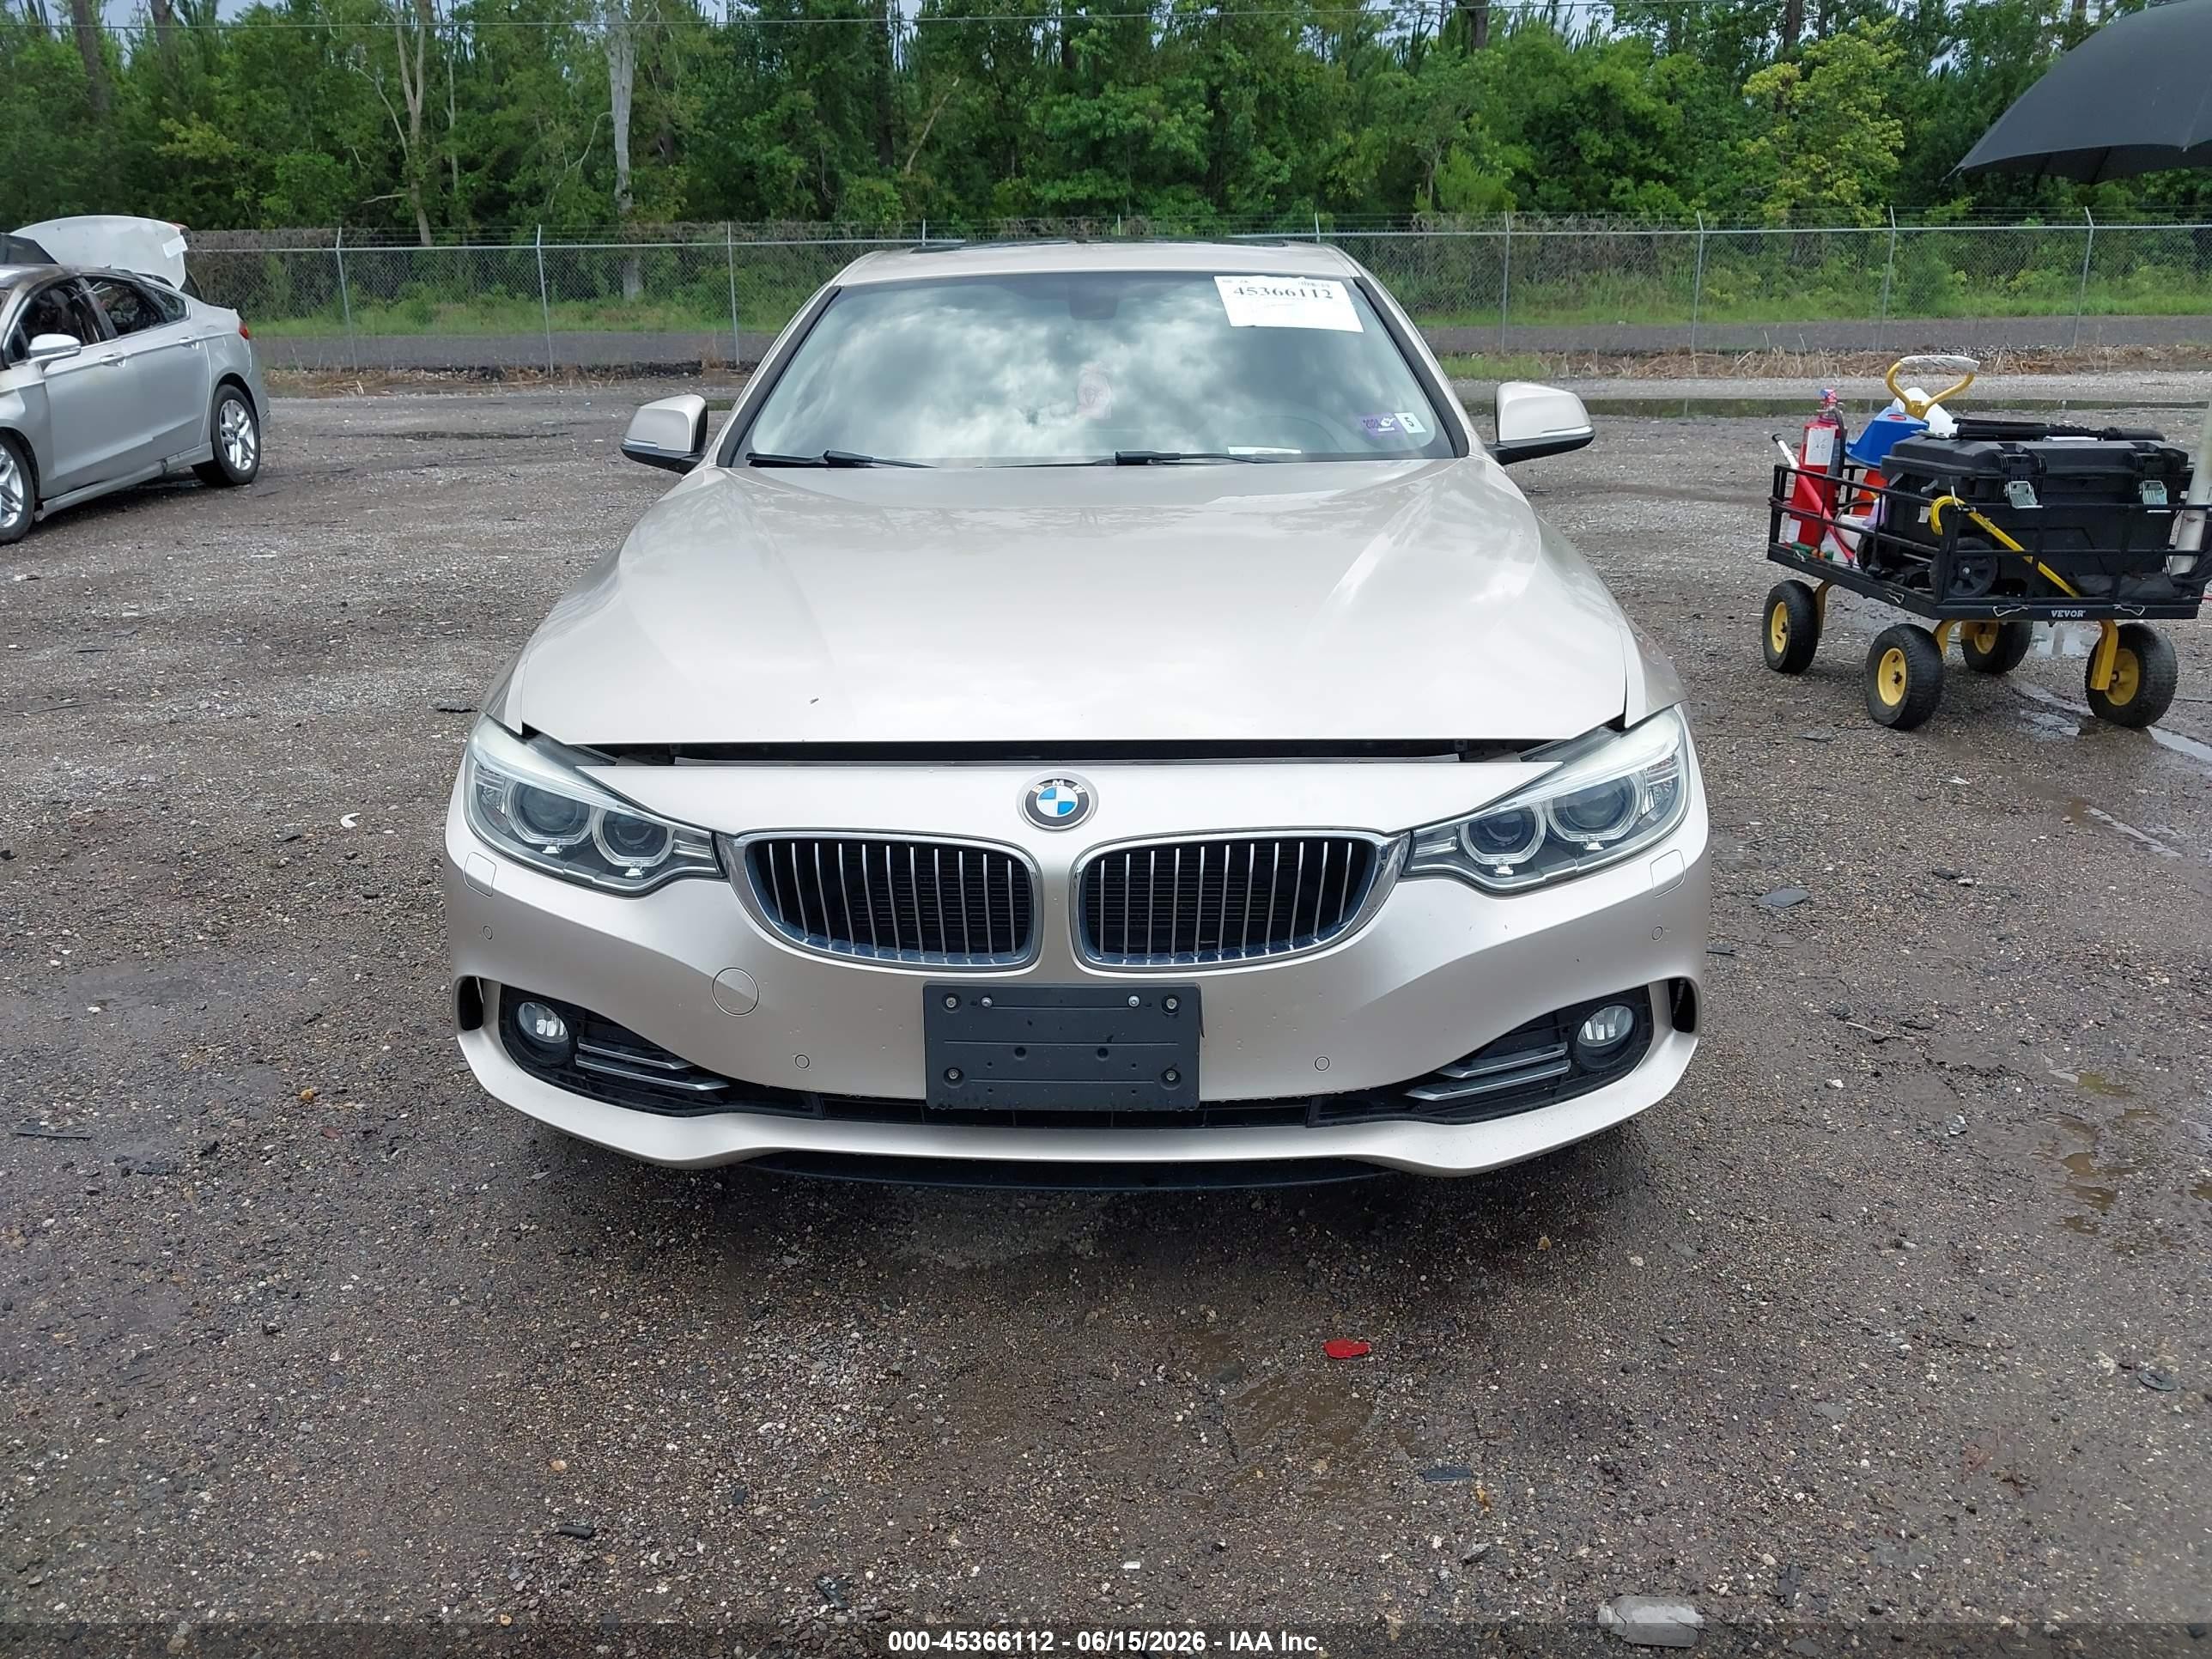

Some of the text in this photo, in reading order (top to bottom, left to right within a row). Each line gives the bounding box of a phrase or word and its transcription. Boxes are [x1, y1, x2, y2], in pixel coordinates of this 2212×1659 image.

[1233, 286, 1334, 299] 45366112
[1404, 416, 1415, 427] 5
[2051, 609, 2084, 617] VEVOR
[1031, 780, 1086, 793] BMW
